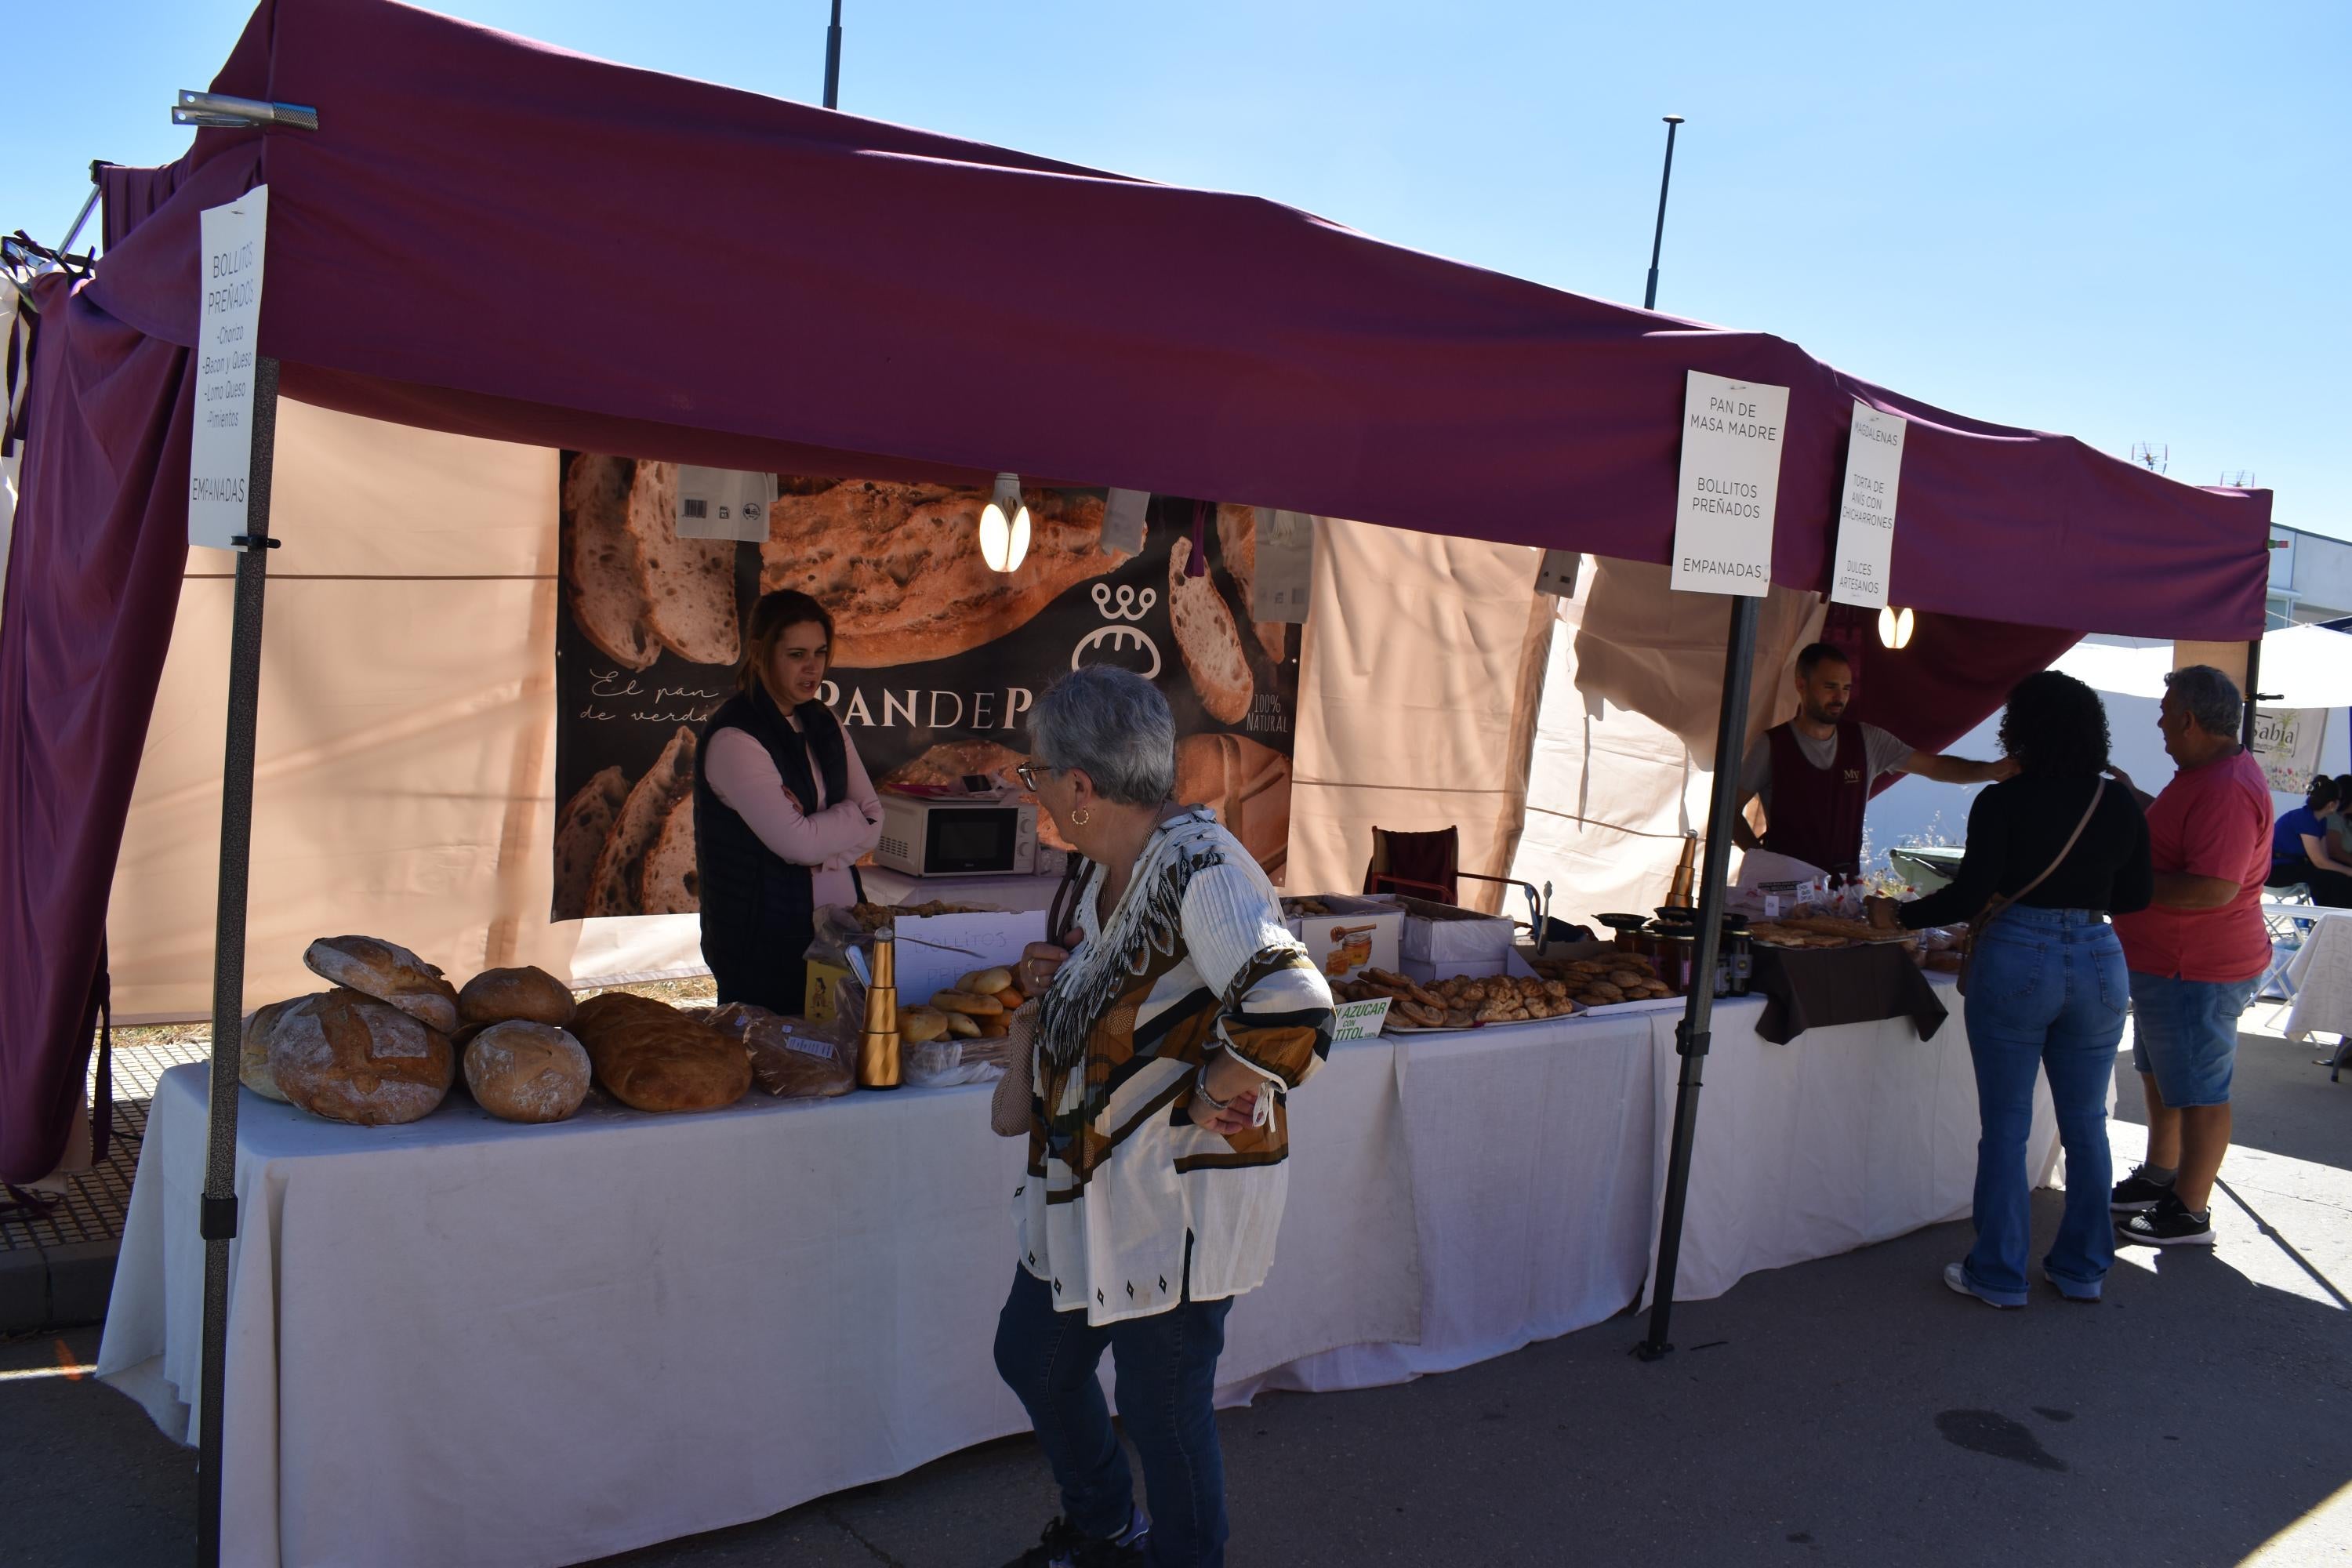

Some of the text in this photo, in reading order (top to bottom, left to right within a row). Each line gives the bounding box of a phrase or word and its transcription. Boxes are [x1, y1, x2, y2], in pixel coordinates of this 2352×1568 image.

[212, 240, 253, 279] BOLLITOS
[208, 278, 253, 315] PREÑADOS
[202, 350, 252, 375] -Bacon y Queso
[205, 380, 246, 401] -Lomo Queso
[1710, 397, 1757, 418] PAN DE
[1690, 413, 1777, 441] MASA MADRE
[1853, 421, 1898, 446] MAGDALENAS
[192, 477, 245, 503] EMPANADAS
[1697, 477, 1757, 498] BOLLITOS
[1853, 474, 1885, 494] TORTA DE
[1692, 497, 1760, 518] PREÑADOS
[1866, 496, 1882, 510] CON
[1842, 506, 1893, 529] CHICHARRONES
[1682, 557, 1762, 579] EMPANADAS
[1846, 560, 1872, 576] DULCES
[1839, 576, 1879, 593] ARTESANOS
[590, 668, 719, 704] El pan
[580, 704, 707, 722] de verda
[814, 679, 1033, 731] PANDEP
[1254, 694, 1281, 713] 100%
[1247, 712, 1288, 733] NATURAL
[1341, 1002, 1387, 1019] AZUCAR
[1333, 1026, 1364, 1042] TITOL
[1342, 1019, 1356, 1028] CON
